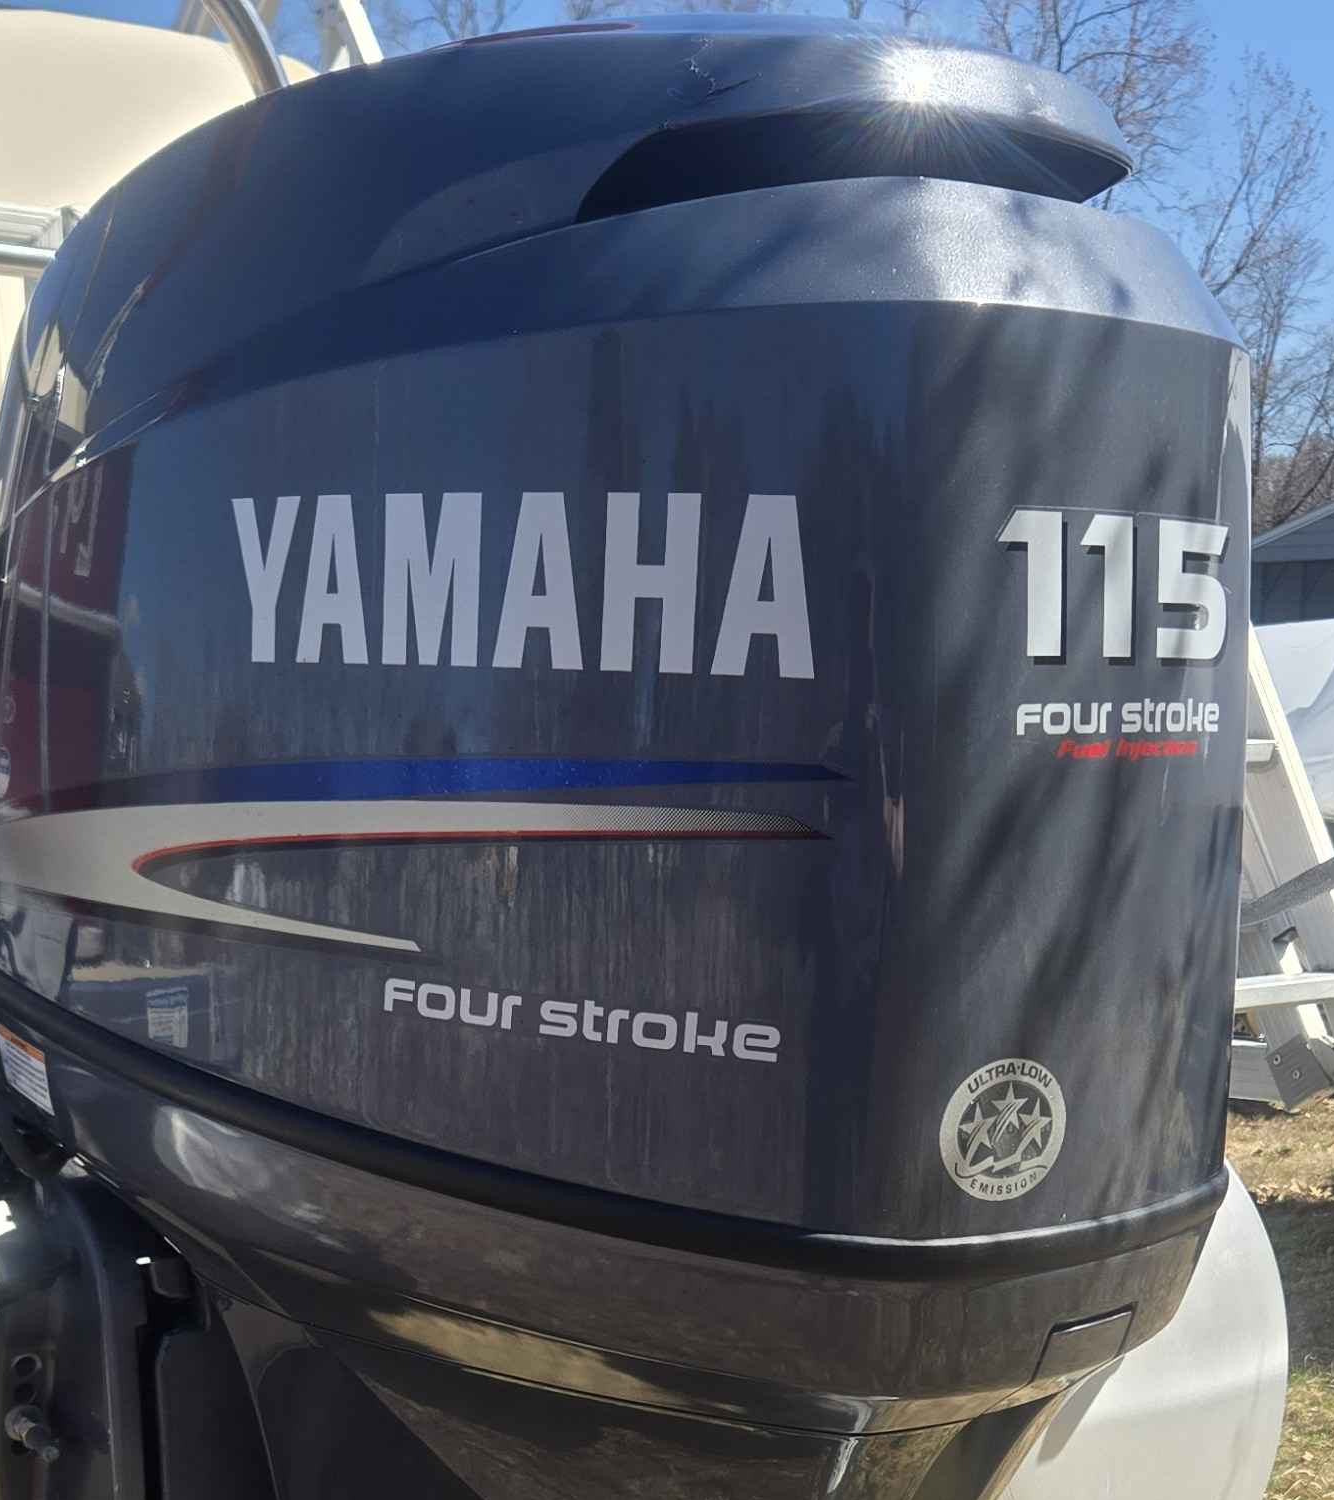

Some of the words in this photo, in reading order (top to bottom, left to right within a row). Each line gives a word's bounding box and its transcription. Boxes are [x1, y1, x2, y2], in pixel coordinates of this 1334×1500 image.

[231, 491, 815, 679] YAMAHA
[997, 509, 1229, 662] 115
[970, 1172, 1037, 1196] EMISSION
